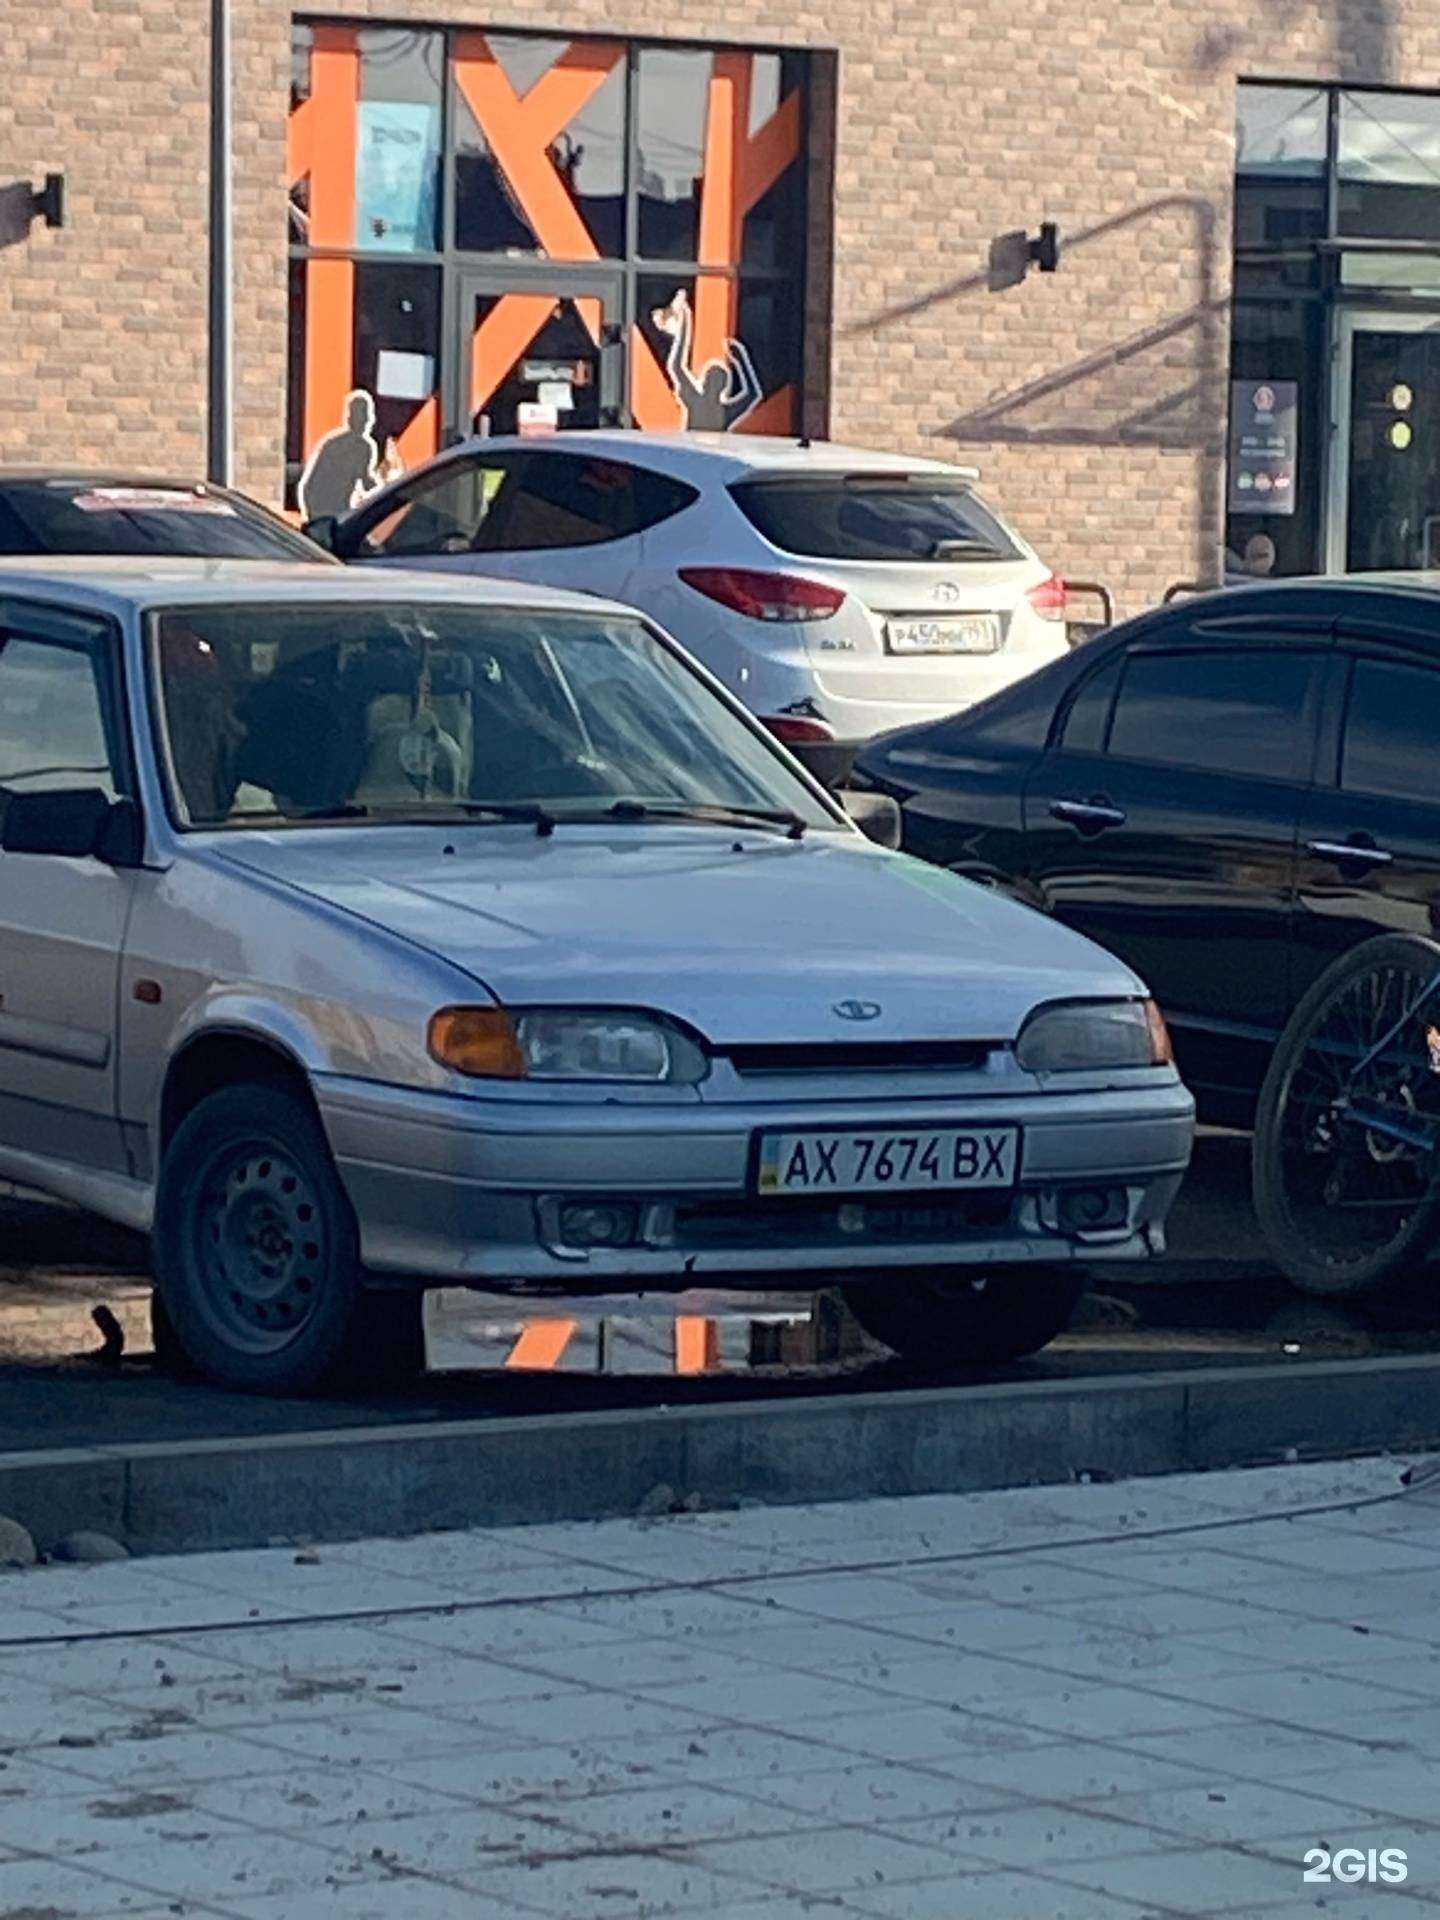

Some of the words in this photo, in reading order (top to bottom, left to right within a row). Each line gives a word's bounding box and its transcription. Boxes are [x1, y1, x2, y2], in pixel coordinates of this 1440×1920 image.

[784, 1139, 840, 1186] AX
[853, 1136, 940, 1183] 7674
[953, 1134, 1008, 1180] BX
